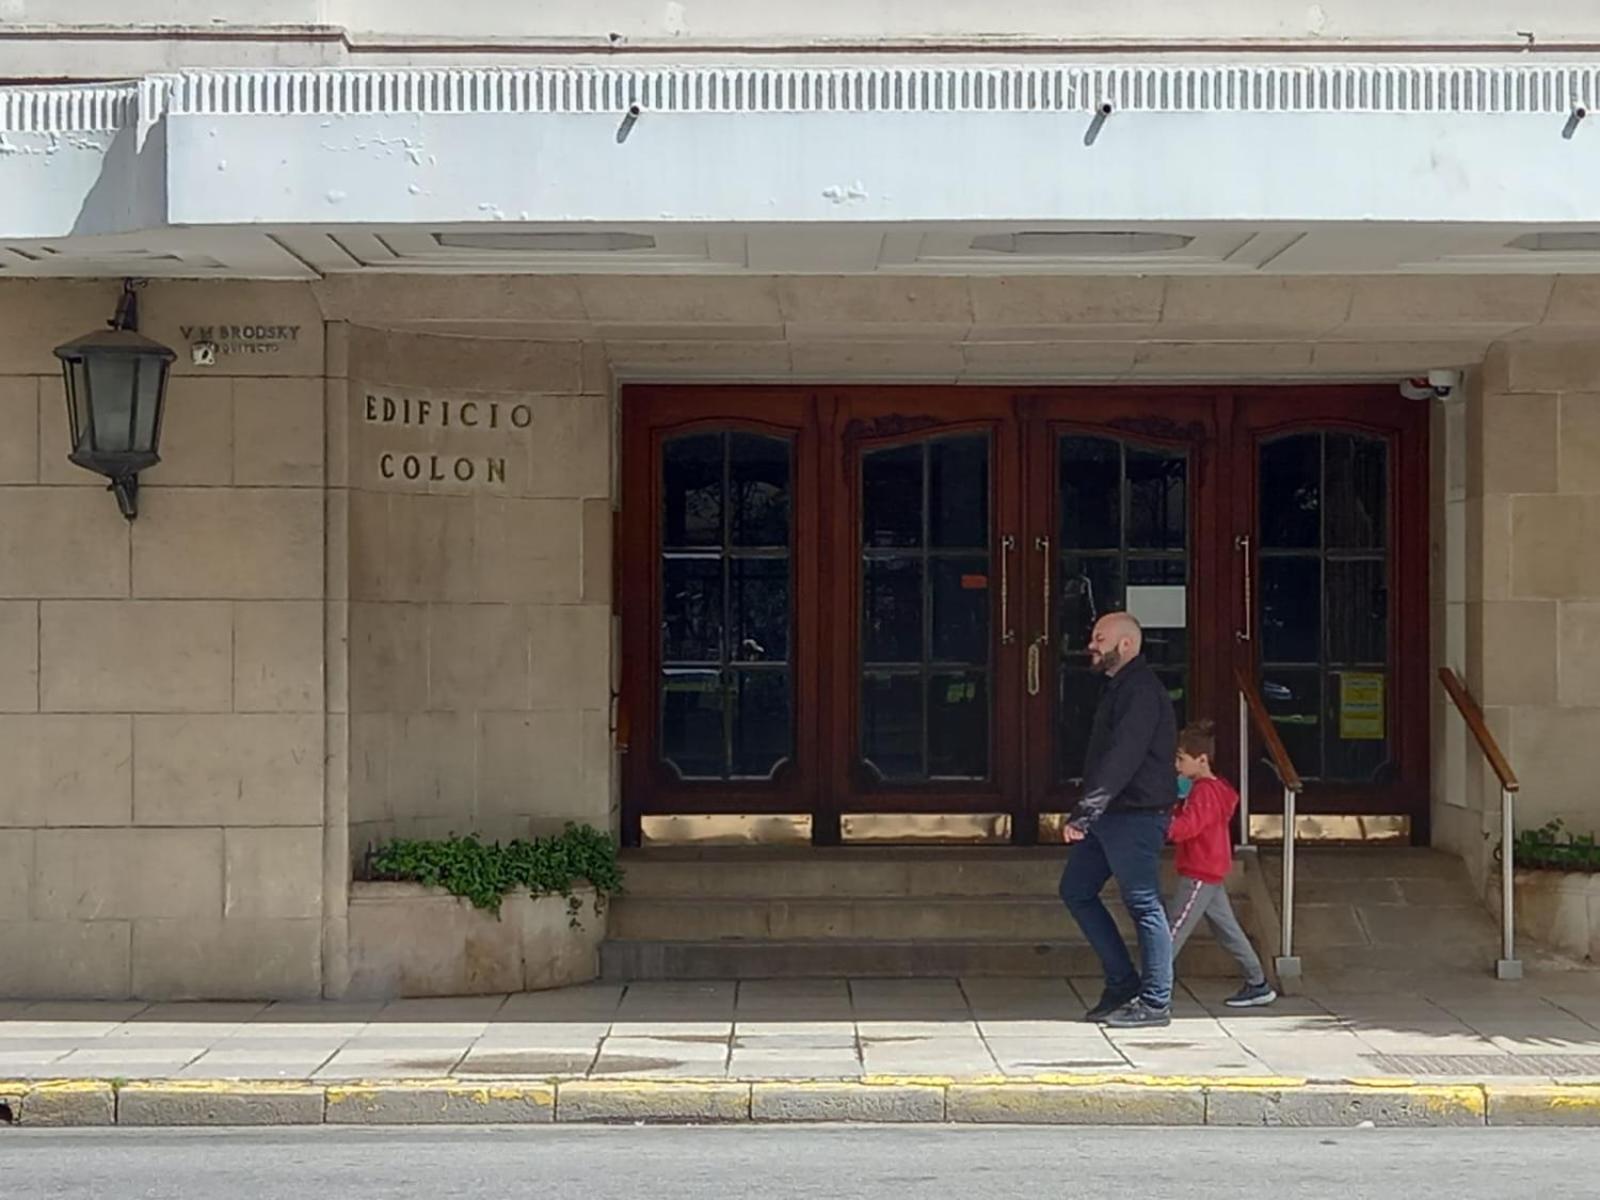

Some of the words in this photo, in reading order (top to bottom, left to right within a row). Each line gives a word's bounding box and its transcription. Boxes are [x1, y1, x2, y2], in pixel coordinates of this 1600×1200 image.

[220, 325, 301, 341] BRODSKY
[366, 395, 532, 428] EDIFICIO
[380, 454, 505, 483] COLON
